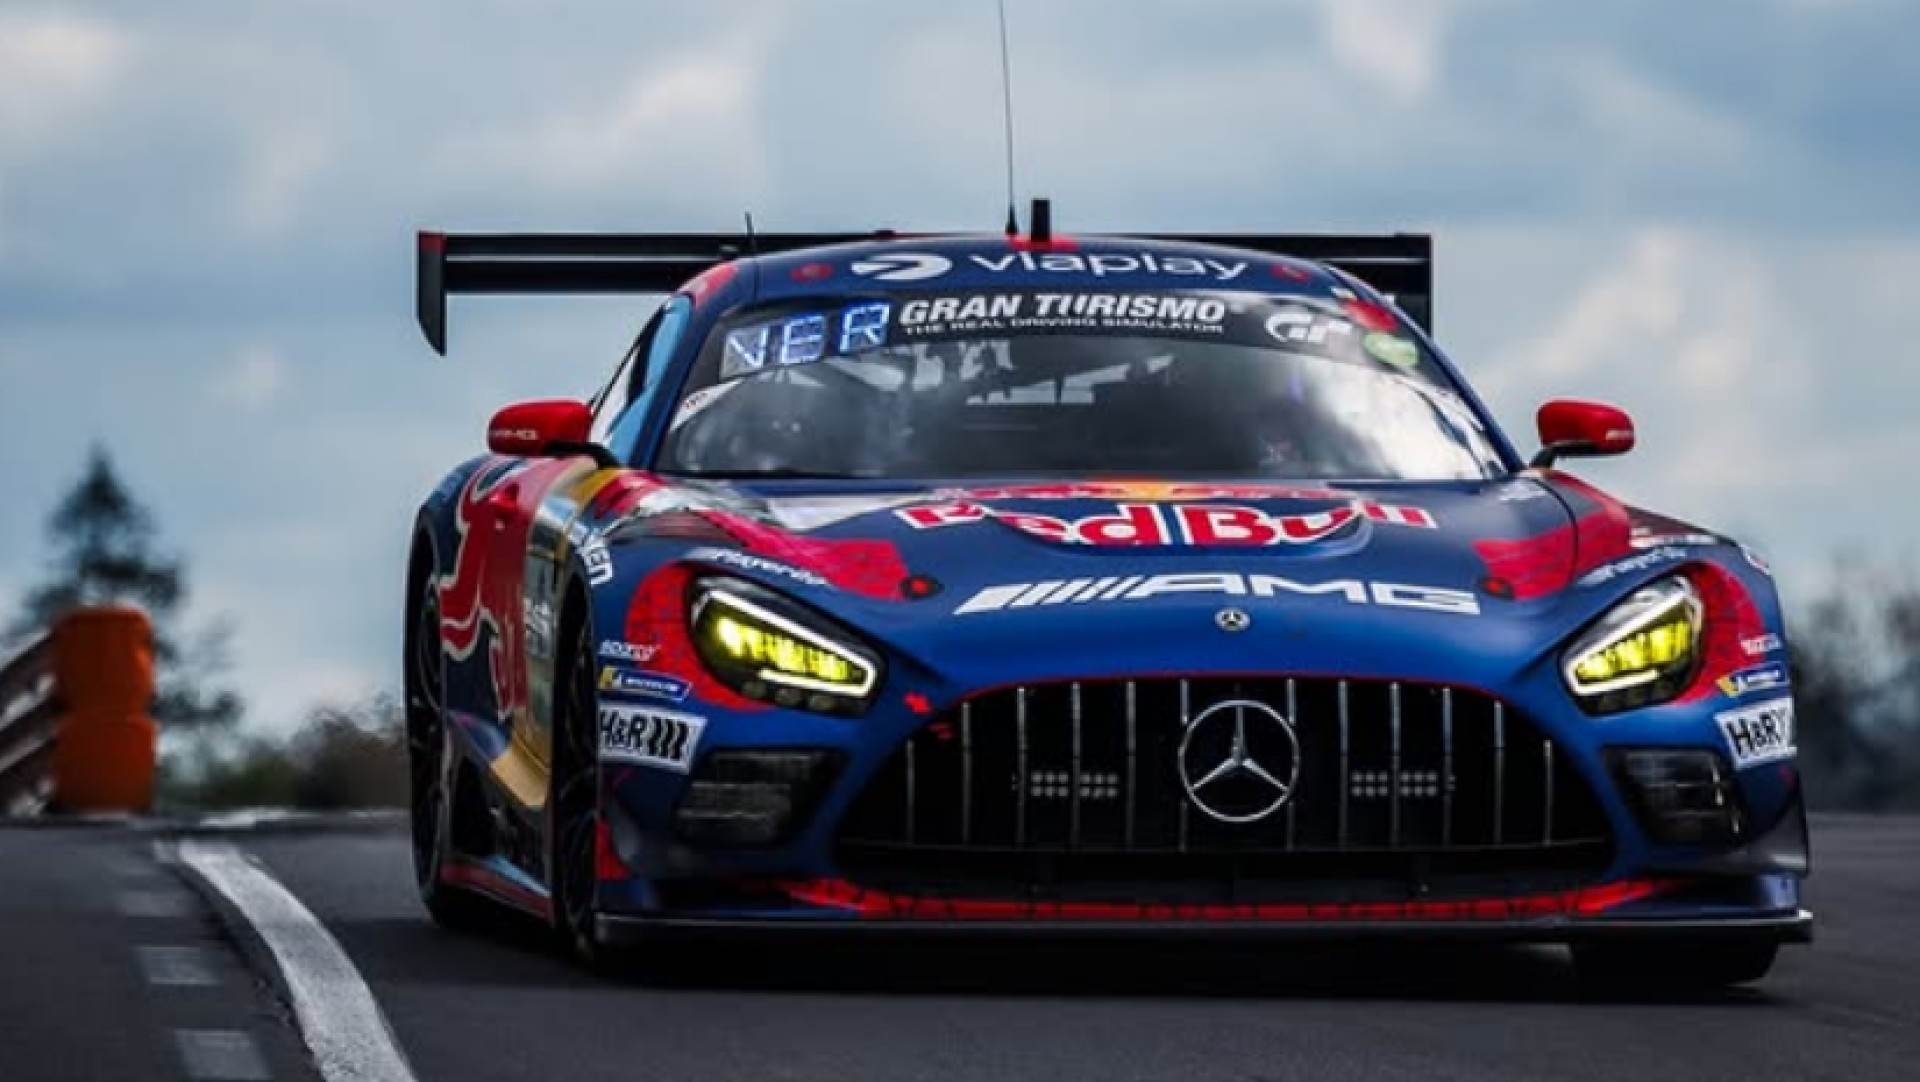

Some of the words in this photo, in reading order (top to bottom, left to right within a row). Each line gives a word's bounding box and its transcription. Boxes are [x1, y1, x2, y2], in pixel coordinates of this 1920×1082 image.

[968, 250, 1248, 281] viaplay
[899, 295, 1023, 325] GRAN
[1035, 293, 1225, 322] TURISMO
[951, 317, 1005, 330] REAL
[726, 303, 890, 370] VER
[1264, 312, 1352, 342] GT
[893, 500, 1174, 547] Red
[1177, 499, 1439, 547] Bull
